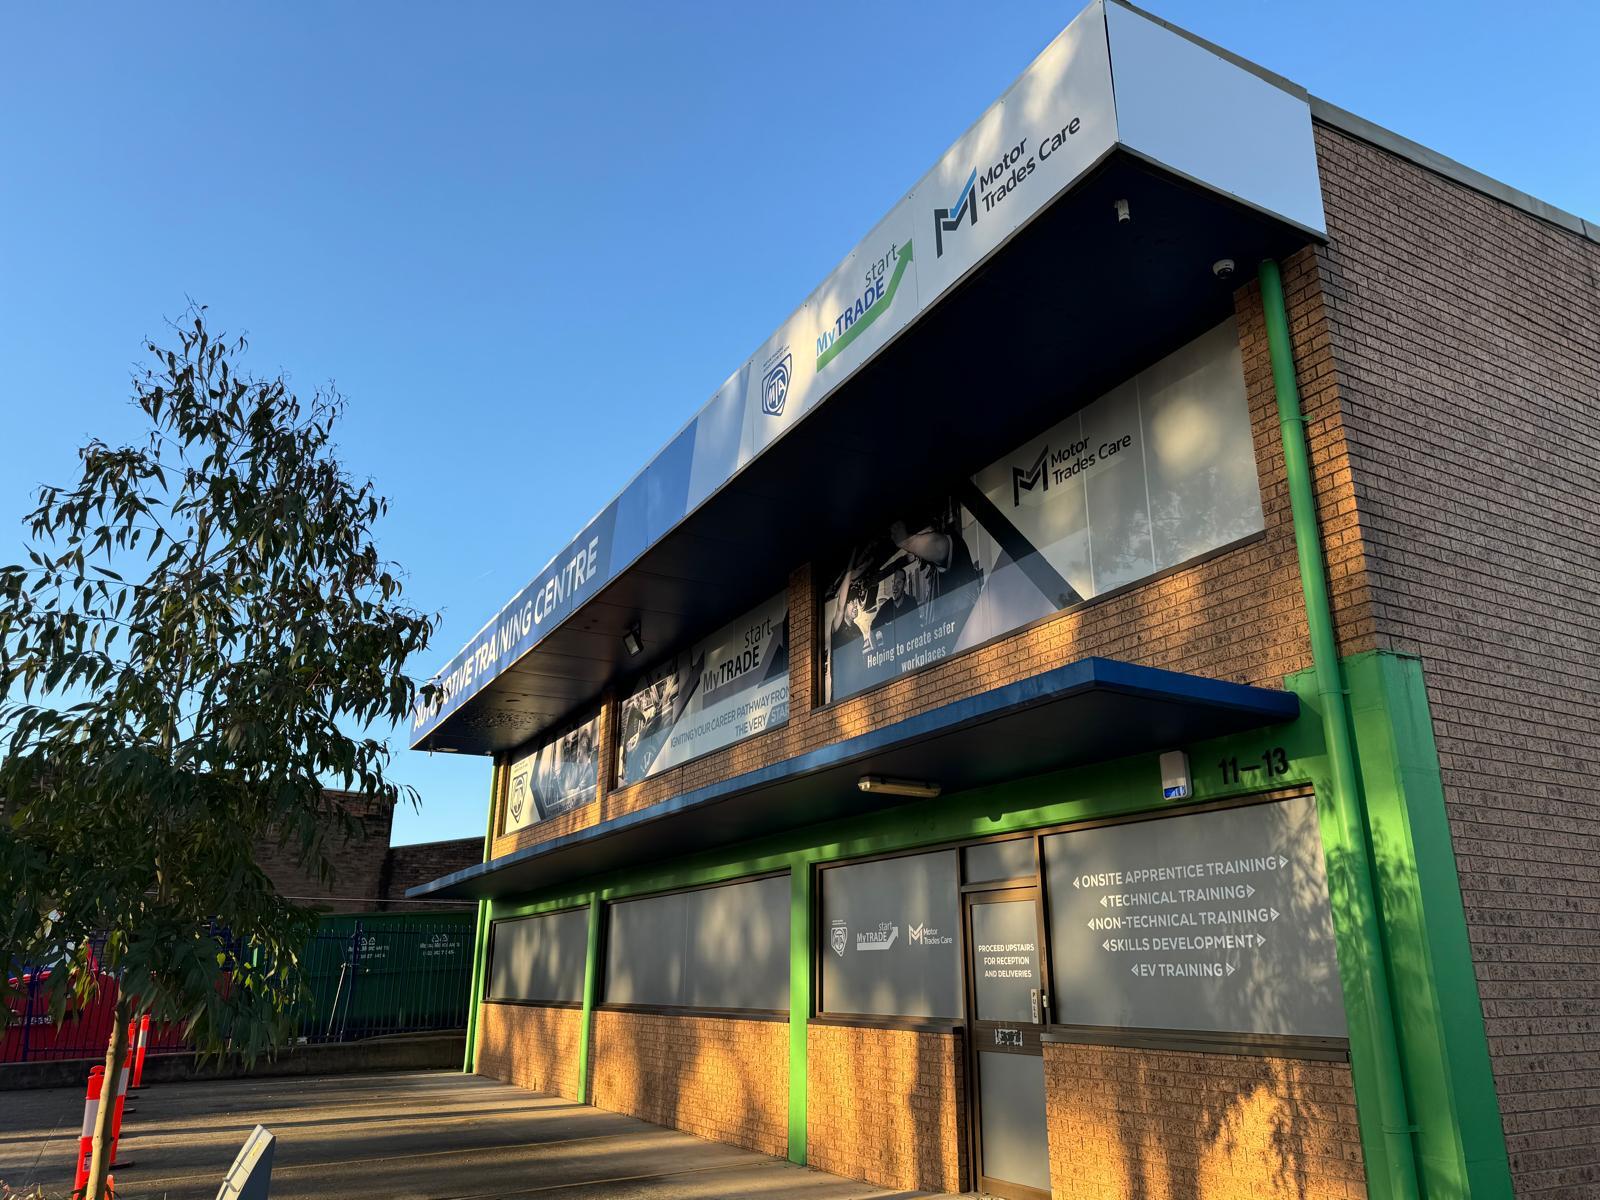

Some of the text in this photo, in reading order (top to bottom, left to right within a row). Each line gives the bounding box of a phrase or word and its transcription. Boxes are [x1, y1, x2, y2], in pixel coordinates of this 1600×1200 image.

[980, 137, 1027, 193] Motor
[982, 117, 1081, 212] Trades Care
[865, 243, 898, 288] start
[816, 276, 885, 357] MyTRADE
[1051, 437, 1090, 467] Motor
[1053, 435, 1131, 485] Trades Care
[474, 601, 532, 678] TRAINING
[534, 536, 599, 625] CENTRE
[744, 616, 772, 649] start
[867, 621, 955, 668] Helping to create safer
[901, 646, 946, 673] workplaces
[671, 729, 695, 748] IGNITING
[694, 722, 711, 738] YOUR
[712, 710, 736, 730] CAREER
[736, 693, 771, 719] PATHWAY
[735, 722, 748, 737] THE
[748, 713, 767, 731] VERY
[1081, 856, 1276, 888] ONSITE APPRENTICE TRAINING
[1108, 885, 1245, 908] TECHNICAL TRAINING
[878, 921, 893, 931] start
[923, 927, 938, 936] Motor
[1096, 908, 1269, 930] NON-TECHNICAL TRAINING
[924, 936, 953, 945] Trades Care
[978, 943, 1035, 952] PROCEED UPSTAIRS
[1110, 934, 1254, 952] SKILLS DEVELOPMENT
[984, 956, 1030, 965] FOR RECEPTION
[984, 970, 1032, 978] AND DELIVERIES
[1140, 963, 1223, 977] EV TRAINING
